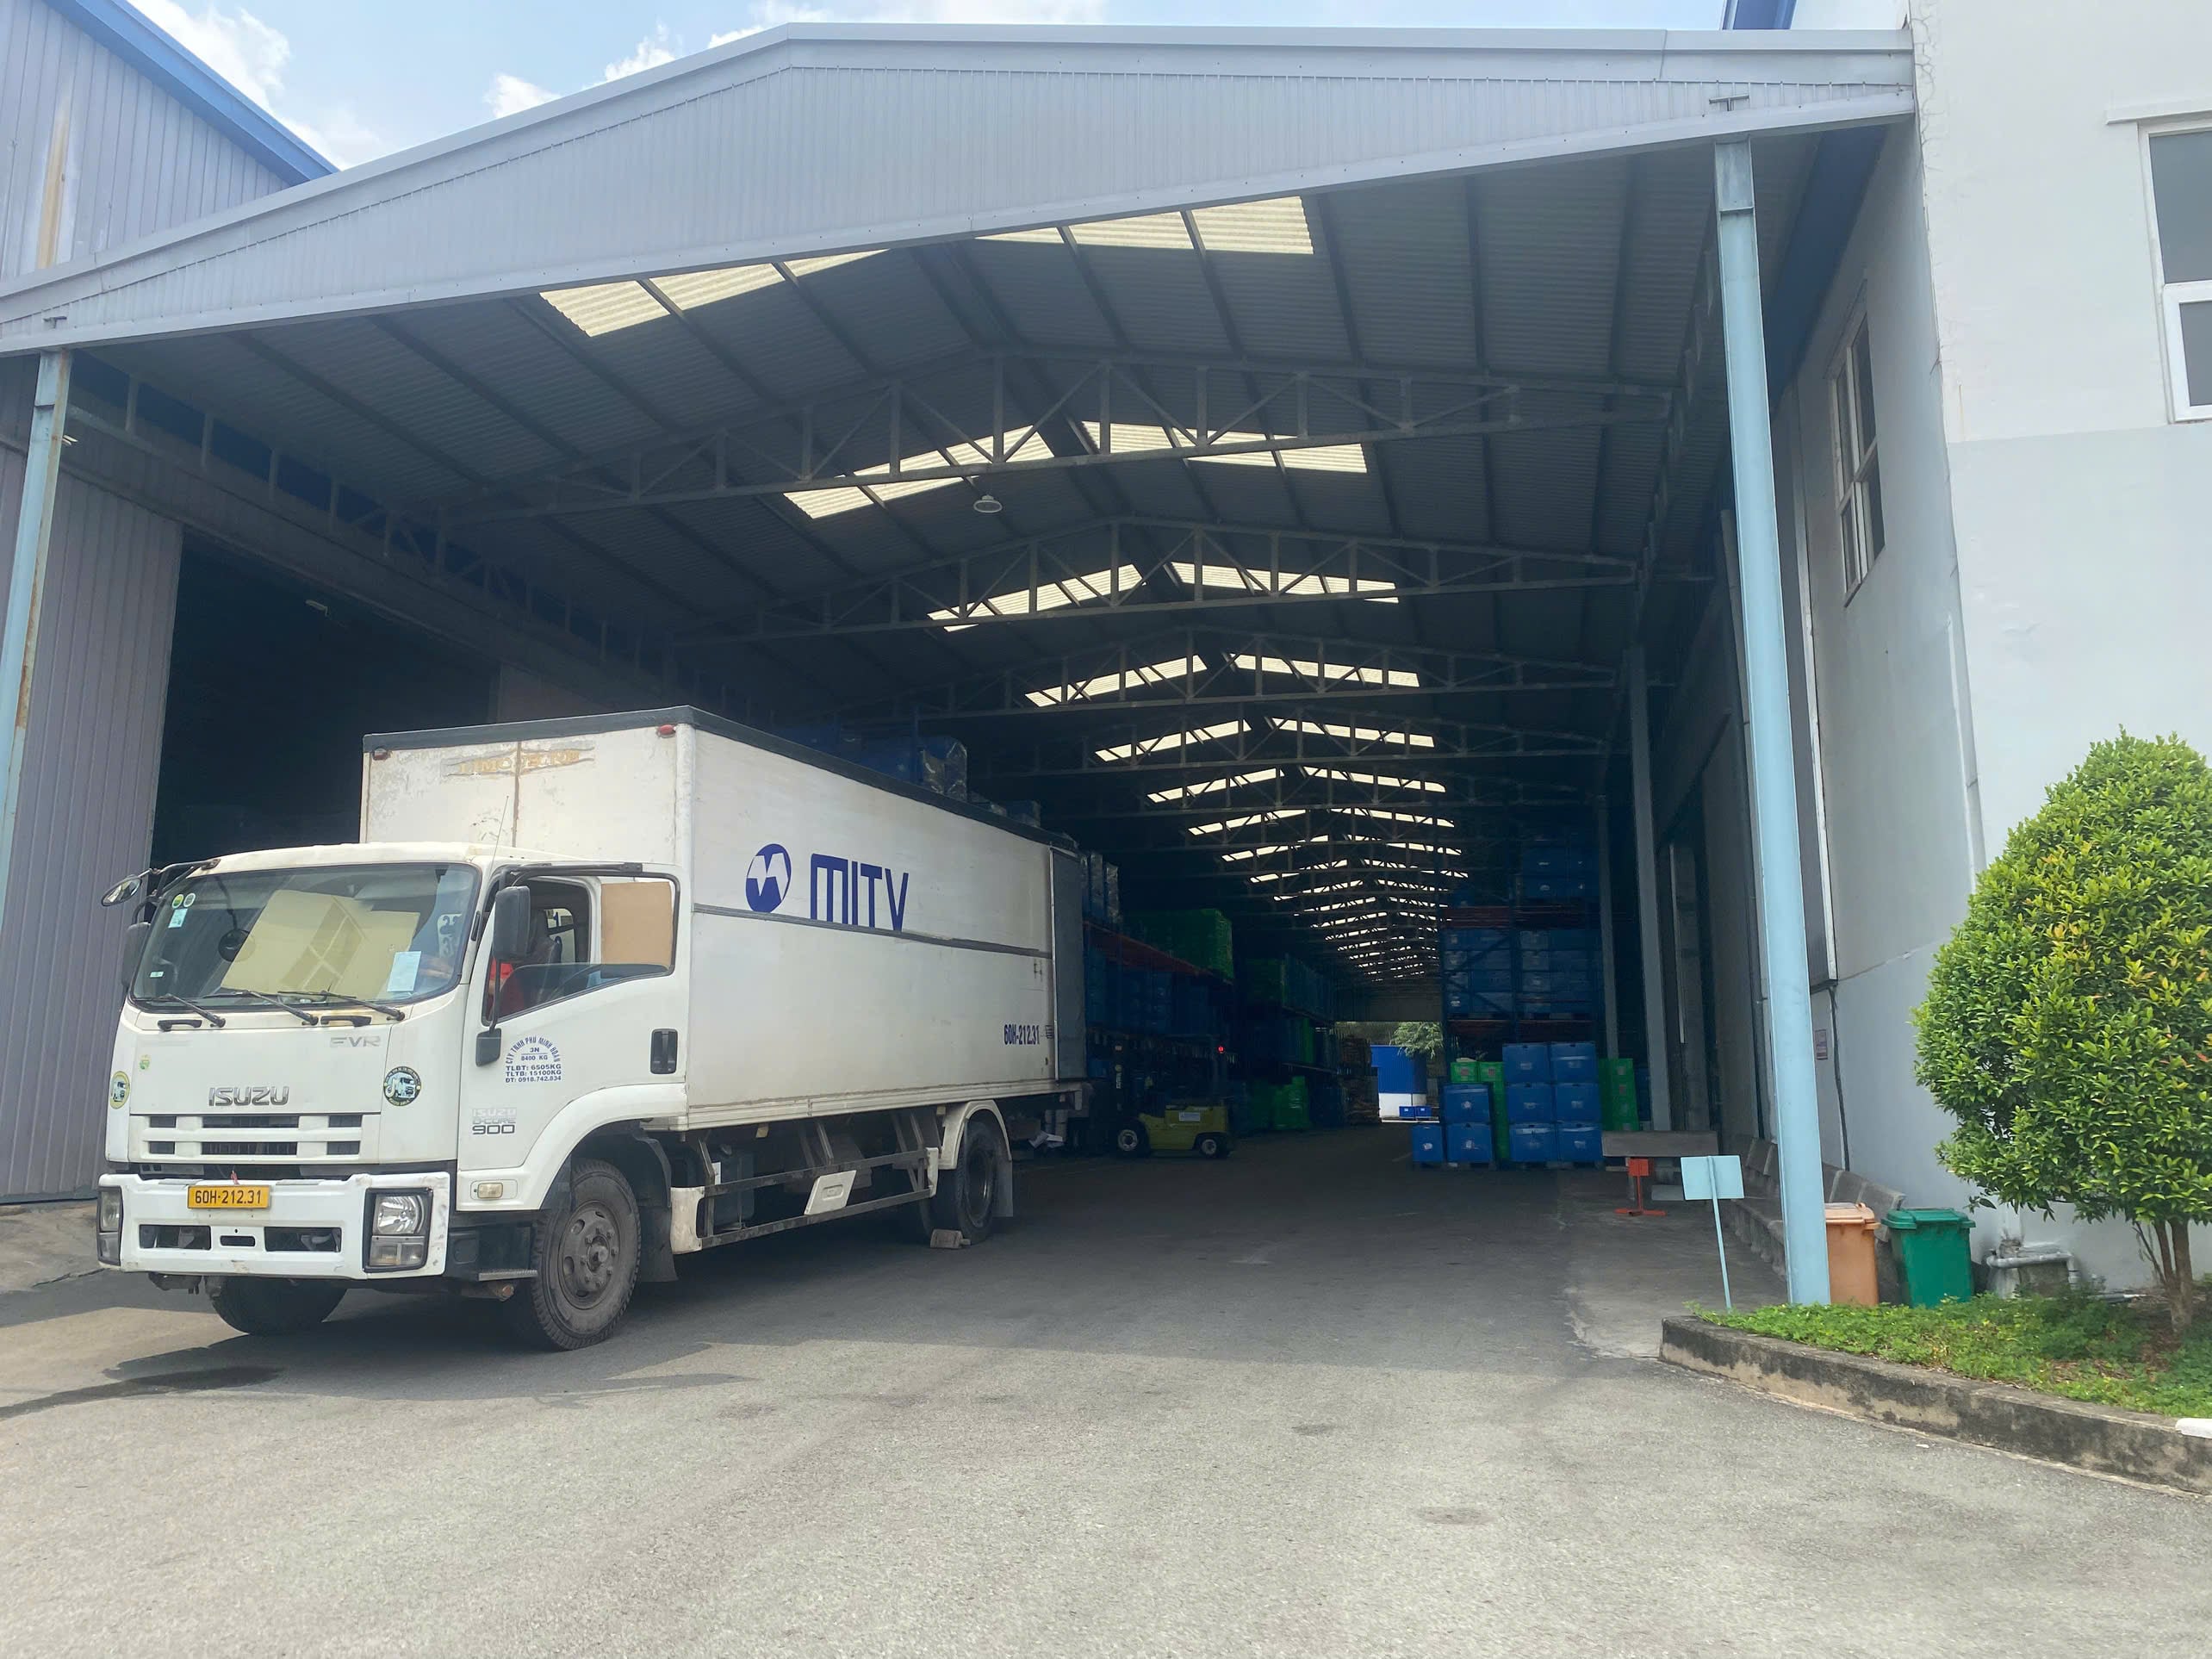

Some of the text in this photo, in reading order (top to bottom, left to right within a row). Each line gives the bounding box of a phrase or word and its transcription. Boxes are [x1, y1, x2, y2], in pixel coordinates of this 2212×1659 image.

[811, 853, 909, 931] MITV
[330, 1036, 380, 1047] FVR
[208, 1086, 289, 1107] ISUZU
[472, 1125, 515, 1134] 900
